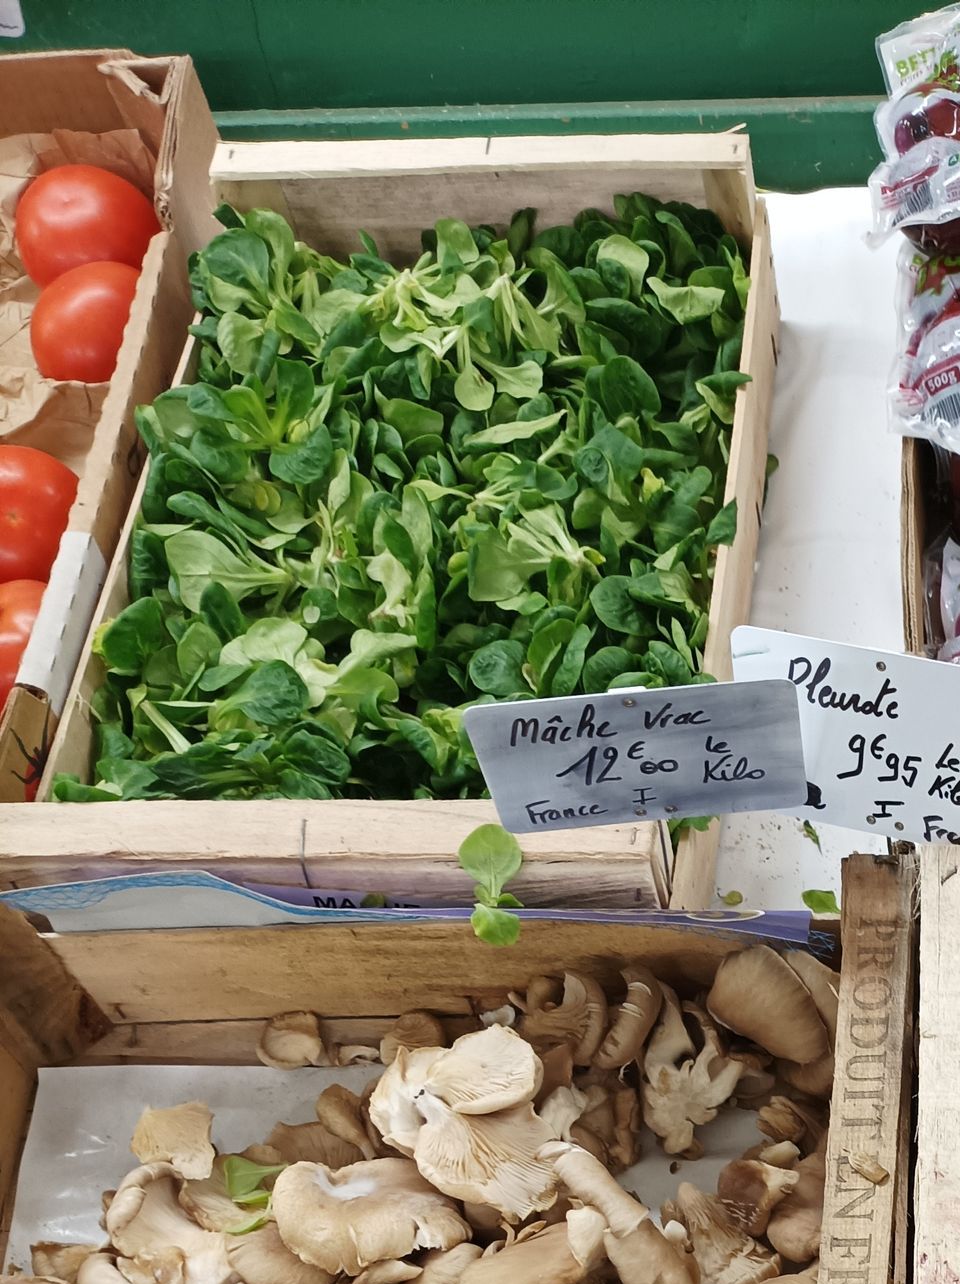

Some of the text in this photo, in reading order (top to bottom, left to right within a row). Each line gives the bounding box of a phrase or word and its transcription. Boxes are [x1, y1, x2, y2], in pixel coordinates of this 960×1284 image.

[509, 703, 618, 748] Mâche
[525, 799, 609, 825] France
[841, 918, 900, 1141] PRODUIT
